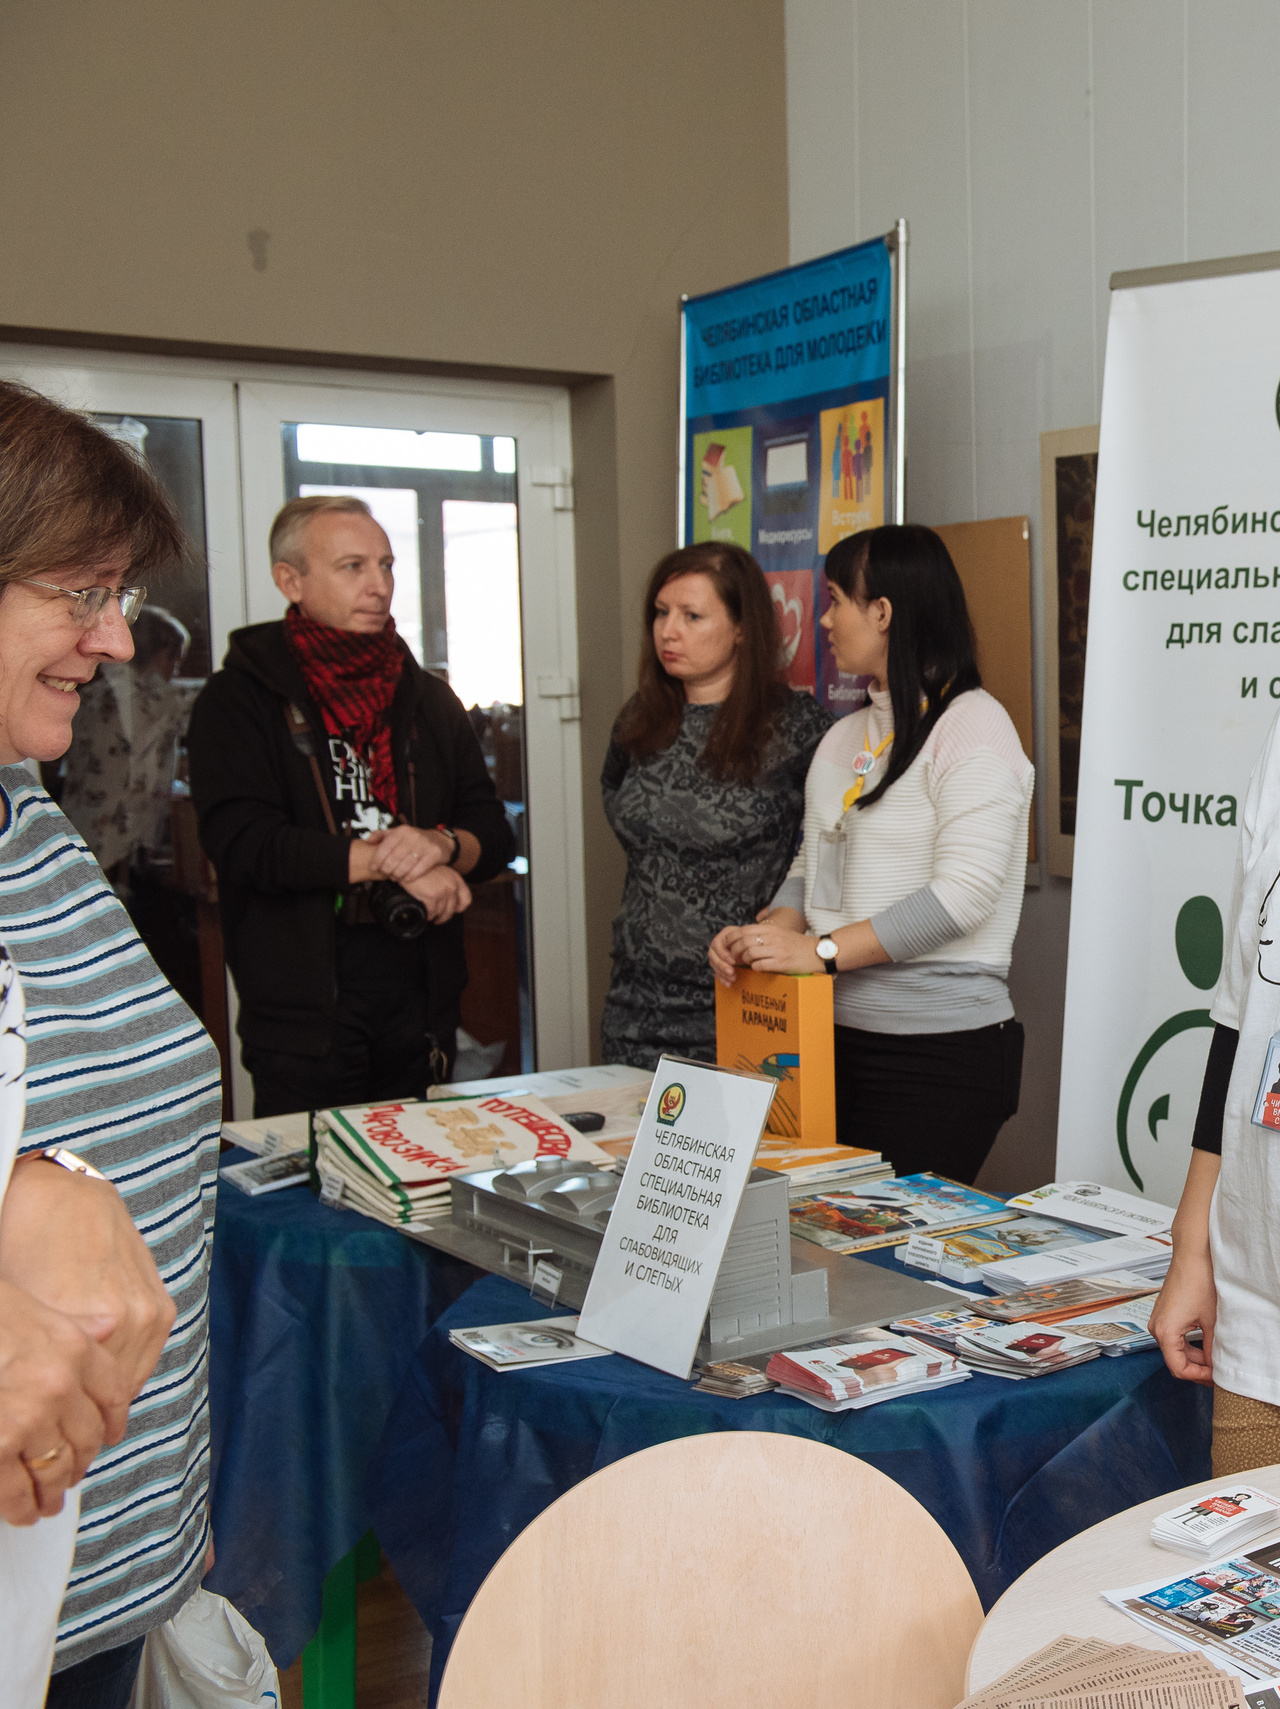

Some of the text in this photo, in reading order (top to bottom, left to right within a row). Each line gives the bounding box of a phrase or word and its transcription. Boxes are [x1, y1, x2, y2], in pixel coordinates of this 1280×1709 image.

[703, 278, 878, 349] ЧЕЛЯБИНСКАЯ ОБЛАСТНАЯ
[693, 352, 772, 389] БИБЛИОТЕКА
[775, 341, 803, 374] ДЛЯ
[1166, 622, 1222, 648] для
[1241, 677, 1258, 698] и
[1114, 779, 1238, 827] Точка
[655, 1128, 735, 1164] ЧЕЛЯБИНСКАЯ
[653, 1152, 722, 1184] ОБЛАСТНАЯ
[640, 1172, 723, 1209] СПЕЦИАЛЬНАЯ
[637, 1194, 709, 1230] БИБЛИОТЕКА
[652, 1224, 678, 1245] ДЛЯ
[619, 1236, 703, 1276] СЛАБОВИДЯЩИХ
[624, 1260, 684, 1294] И СЛЕПЫХ
